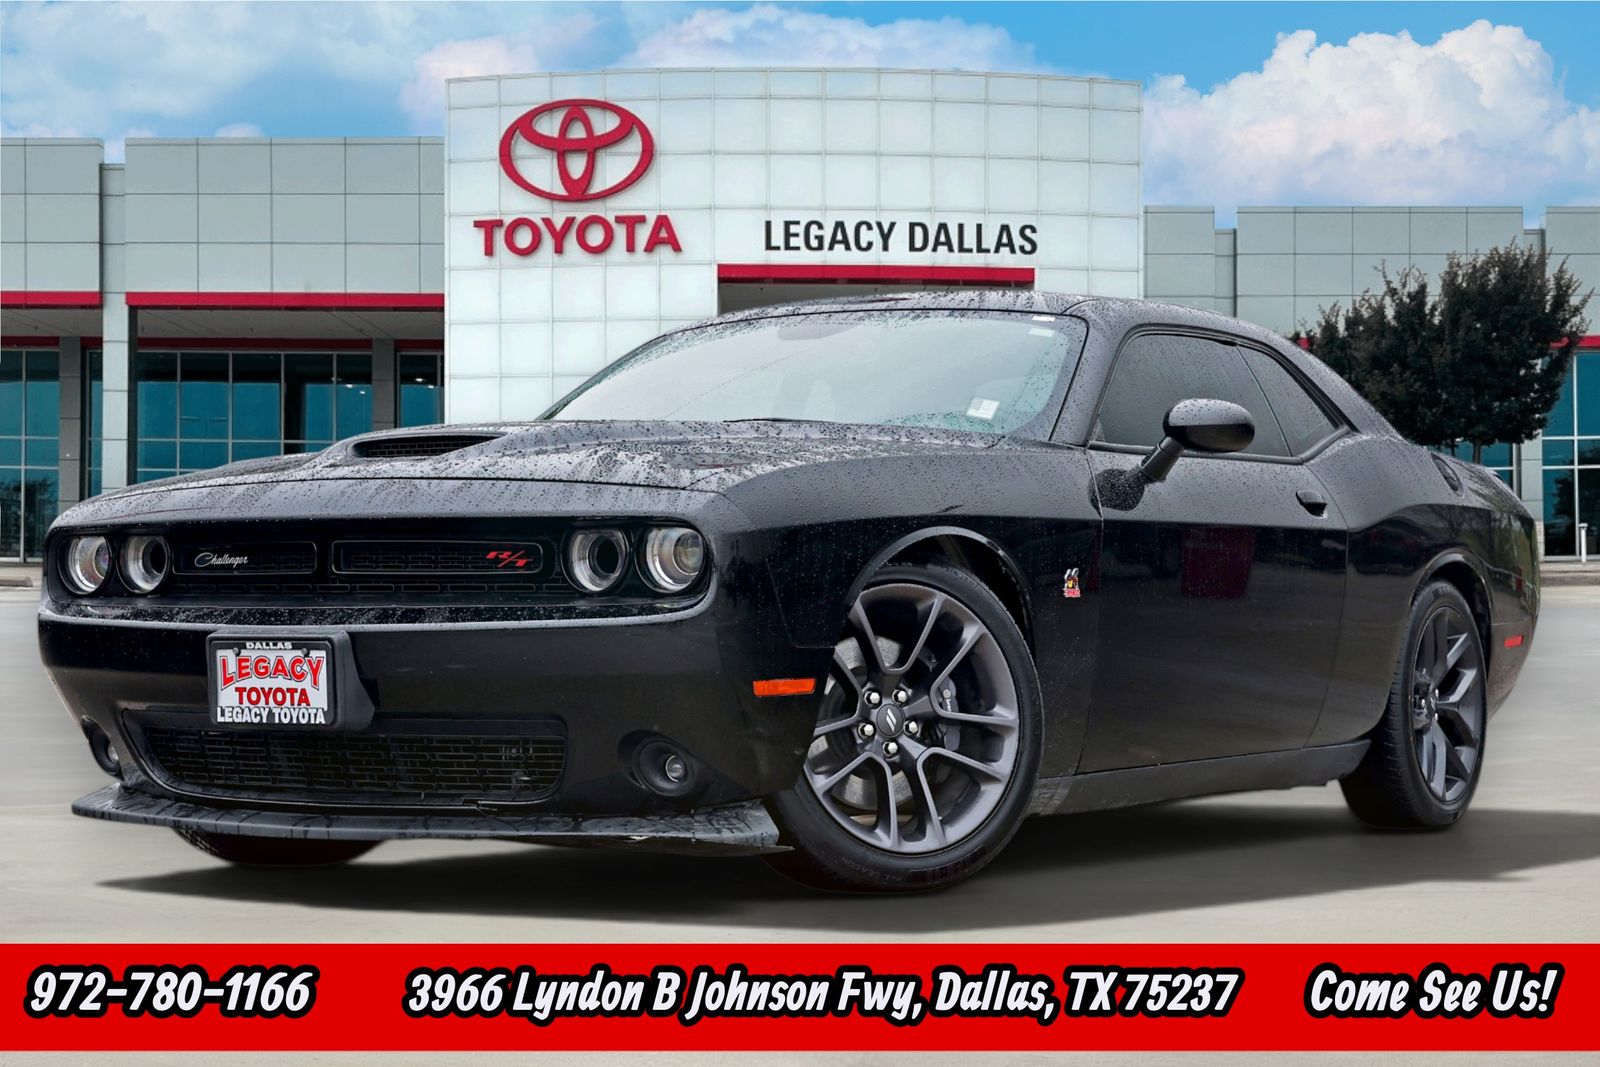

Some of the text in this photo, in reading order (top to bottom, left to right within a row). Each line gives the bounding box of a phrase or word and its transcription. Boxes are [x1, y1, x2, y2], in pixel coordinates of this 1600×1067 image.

[473, 214, 682, 256] TOYOTA
[764, 220, 1038, 255] LEGACY DALLAS
[194, 552, 249, 569] Challenger
[486, 550, 534, 568] R/T
[245, 641, 293, 650] DALLAS
[219, 655, 325, 692] LEGACY
[234, 686, 312, 707] TOYOTA
[216, 706, 326, 725] LEGACY TOYOTA
